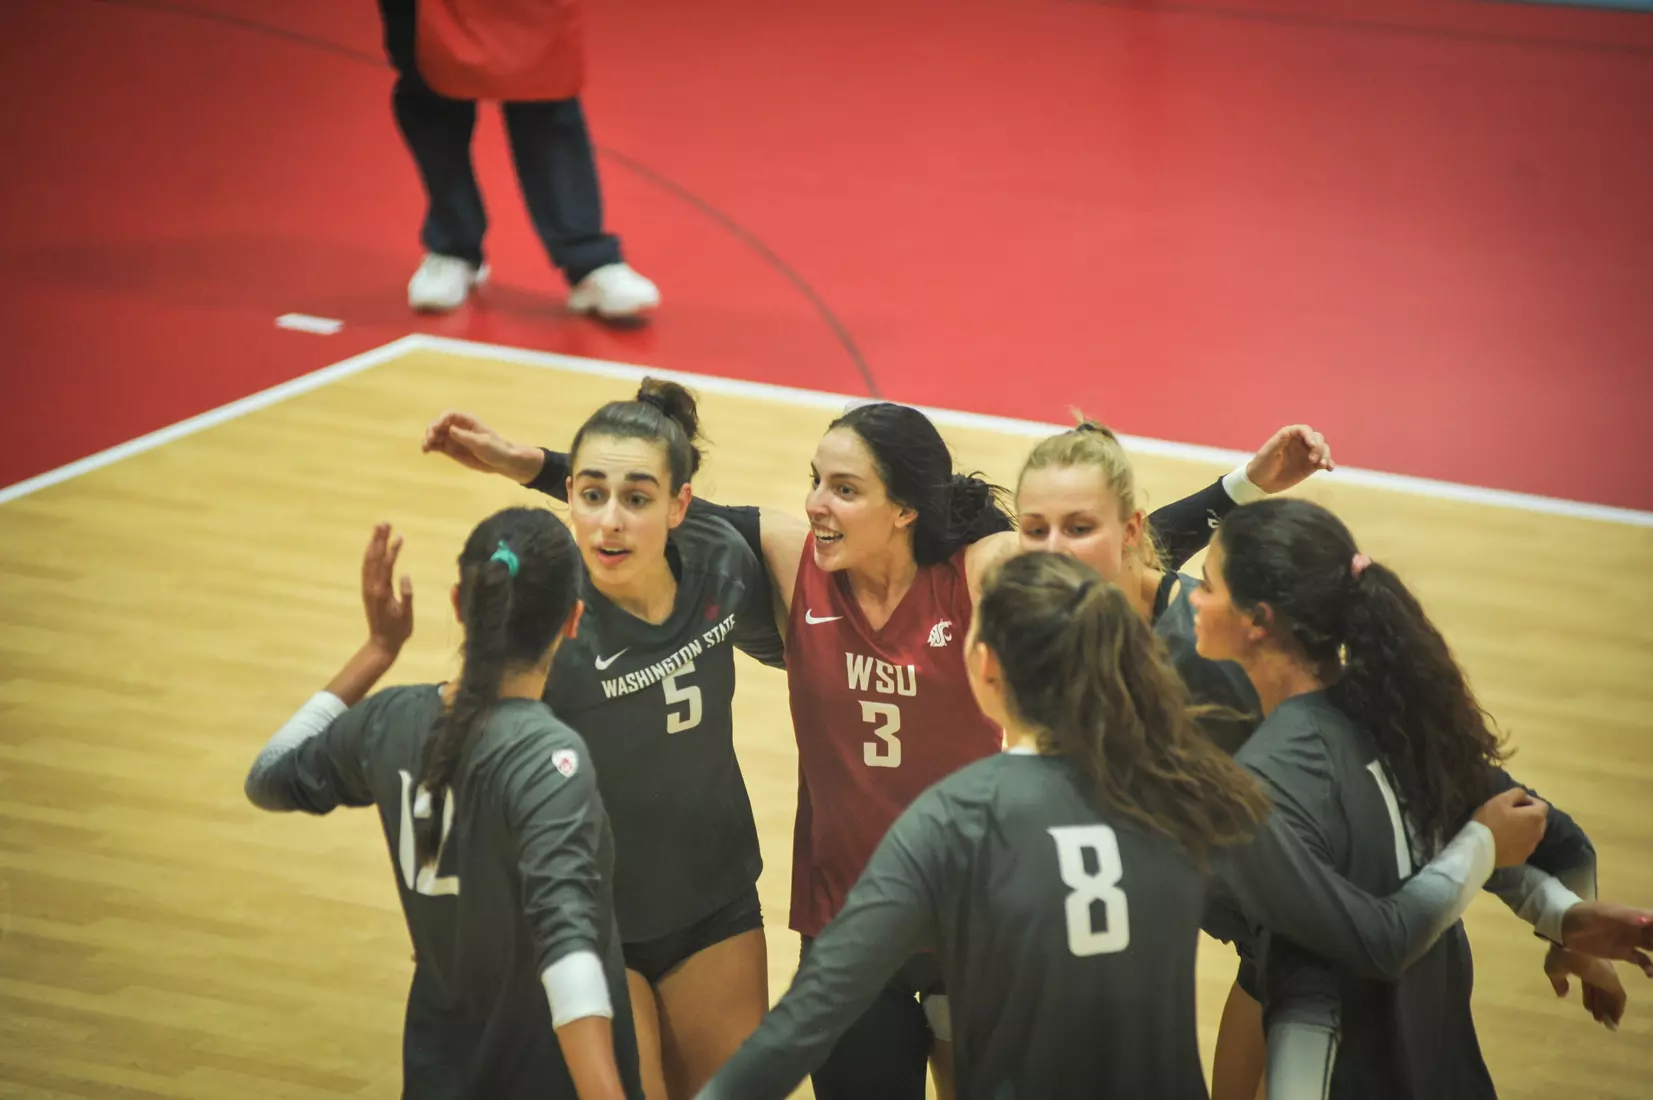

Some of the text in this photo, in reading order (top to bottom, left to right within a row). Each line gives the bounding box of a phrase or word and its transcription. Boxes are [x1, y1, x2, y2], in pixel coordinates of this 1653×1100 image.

[601, 613, 736, 699] WASHINGTON STATE
[845, 652, 917, 697] WSU
[661, 660, 703, 734] 5
[858, 700, 902, 768] 3
[1047, 824, 1131, 957] 8
